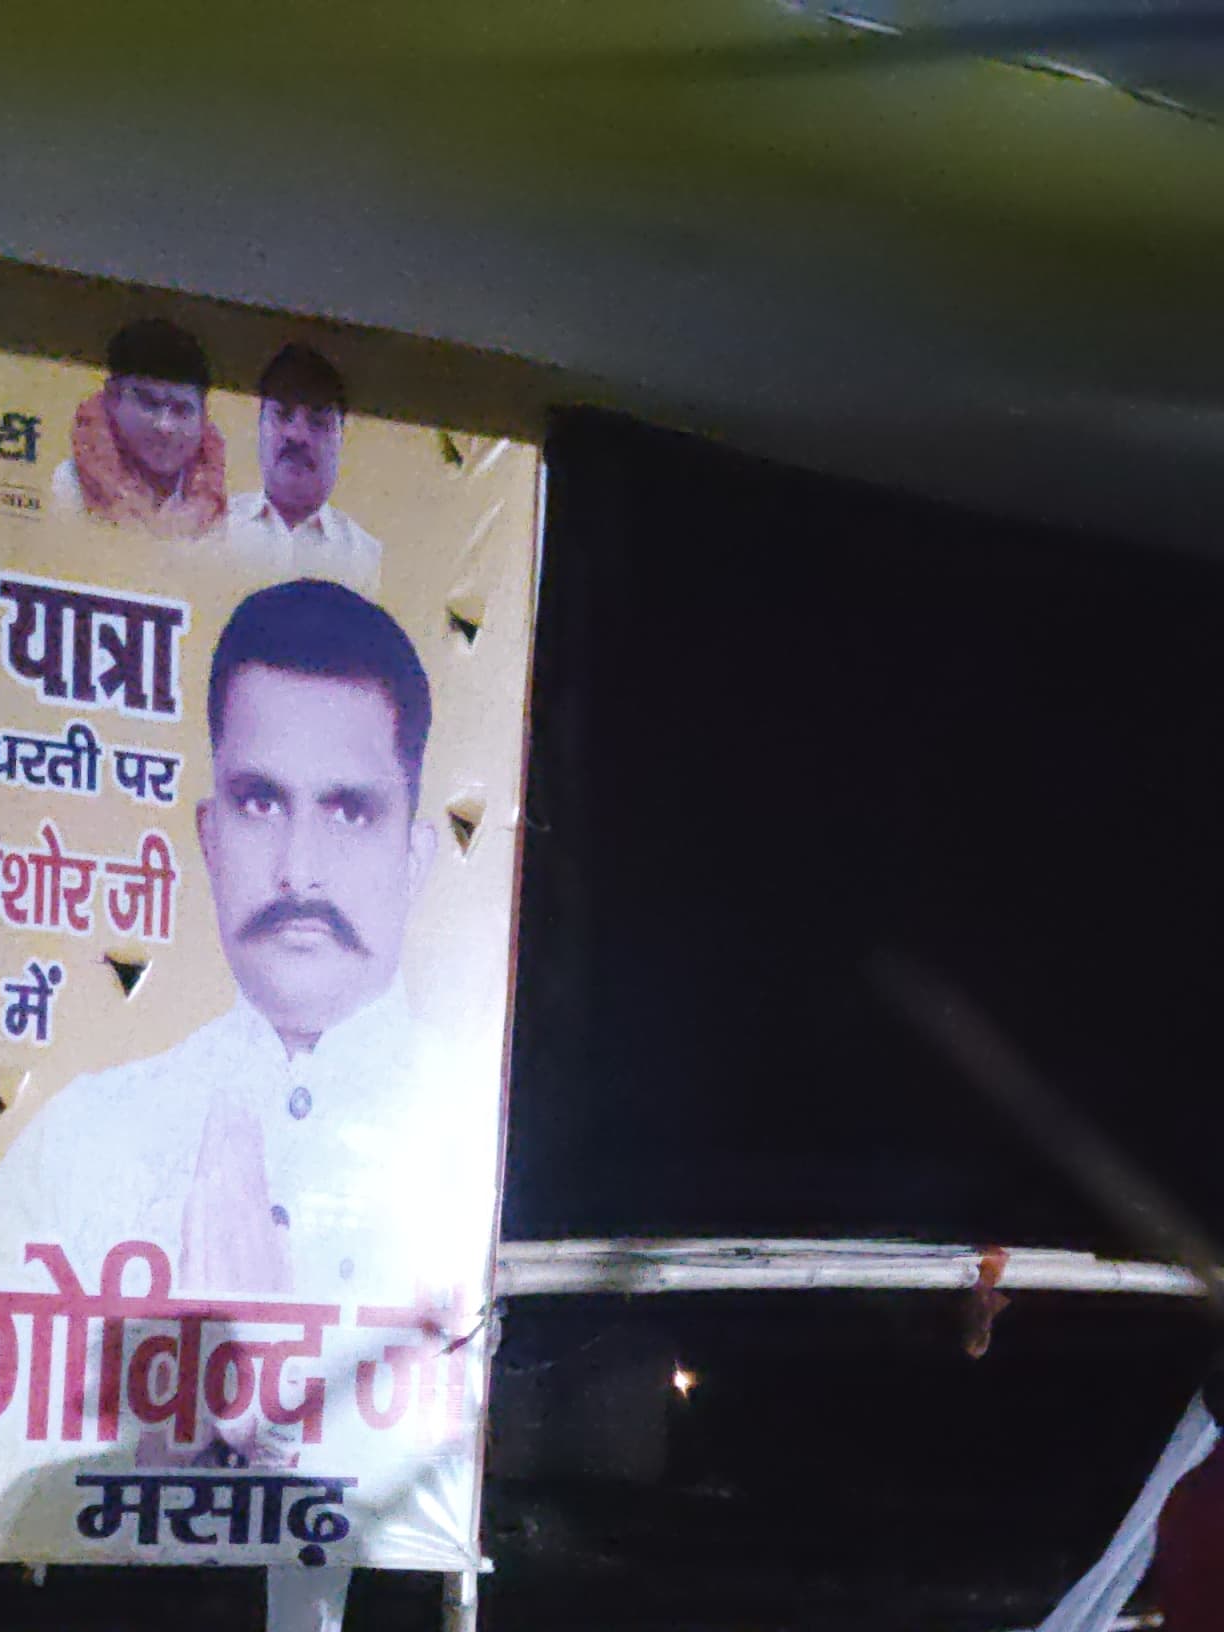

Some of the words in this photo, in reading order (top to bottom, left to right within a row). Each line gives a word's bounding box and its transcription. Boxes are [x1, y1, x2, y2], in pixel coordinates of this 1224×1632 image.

[0, 579, 184, 714] यात्रा
[113, 750, 180, 802] पर
[104, 834, 176, 940] जी
[5, 962, 62, 1041] में
[74, 1474, 360, 1567] मसाढ़
